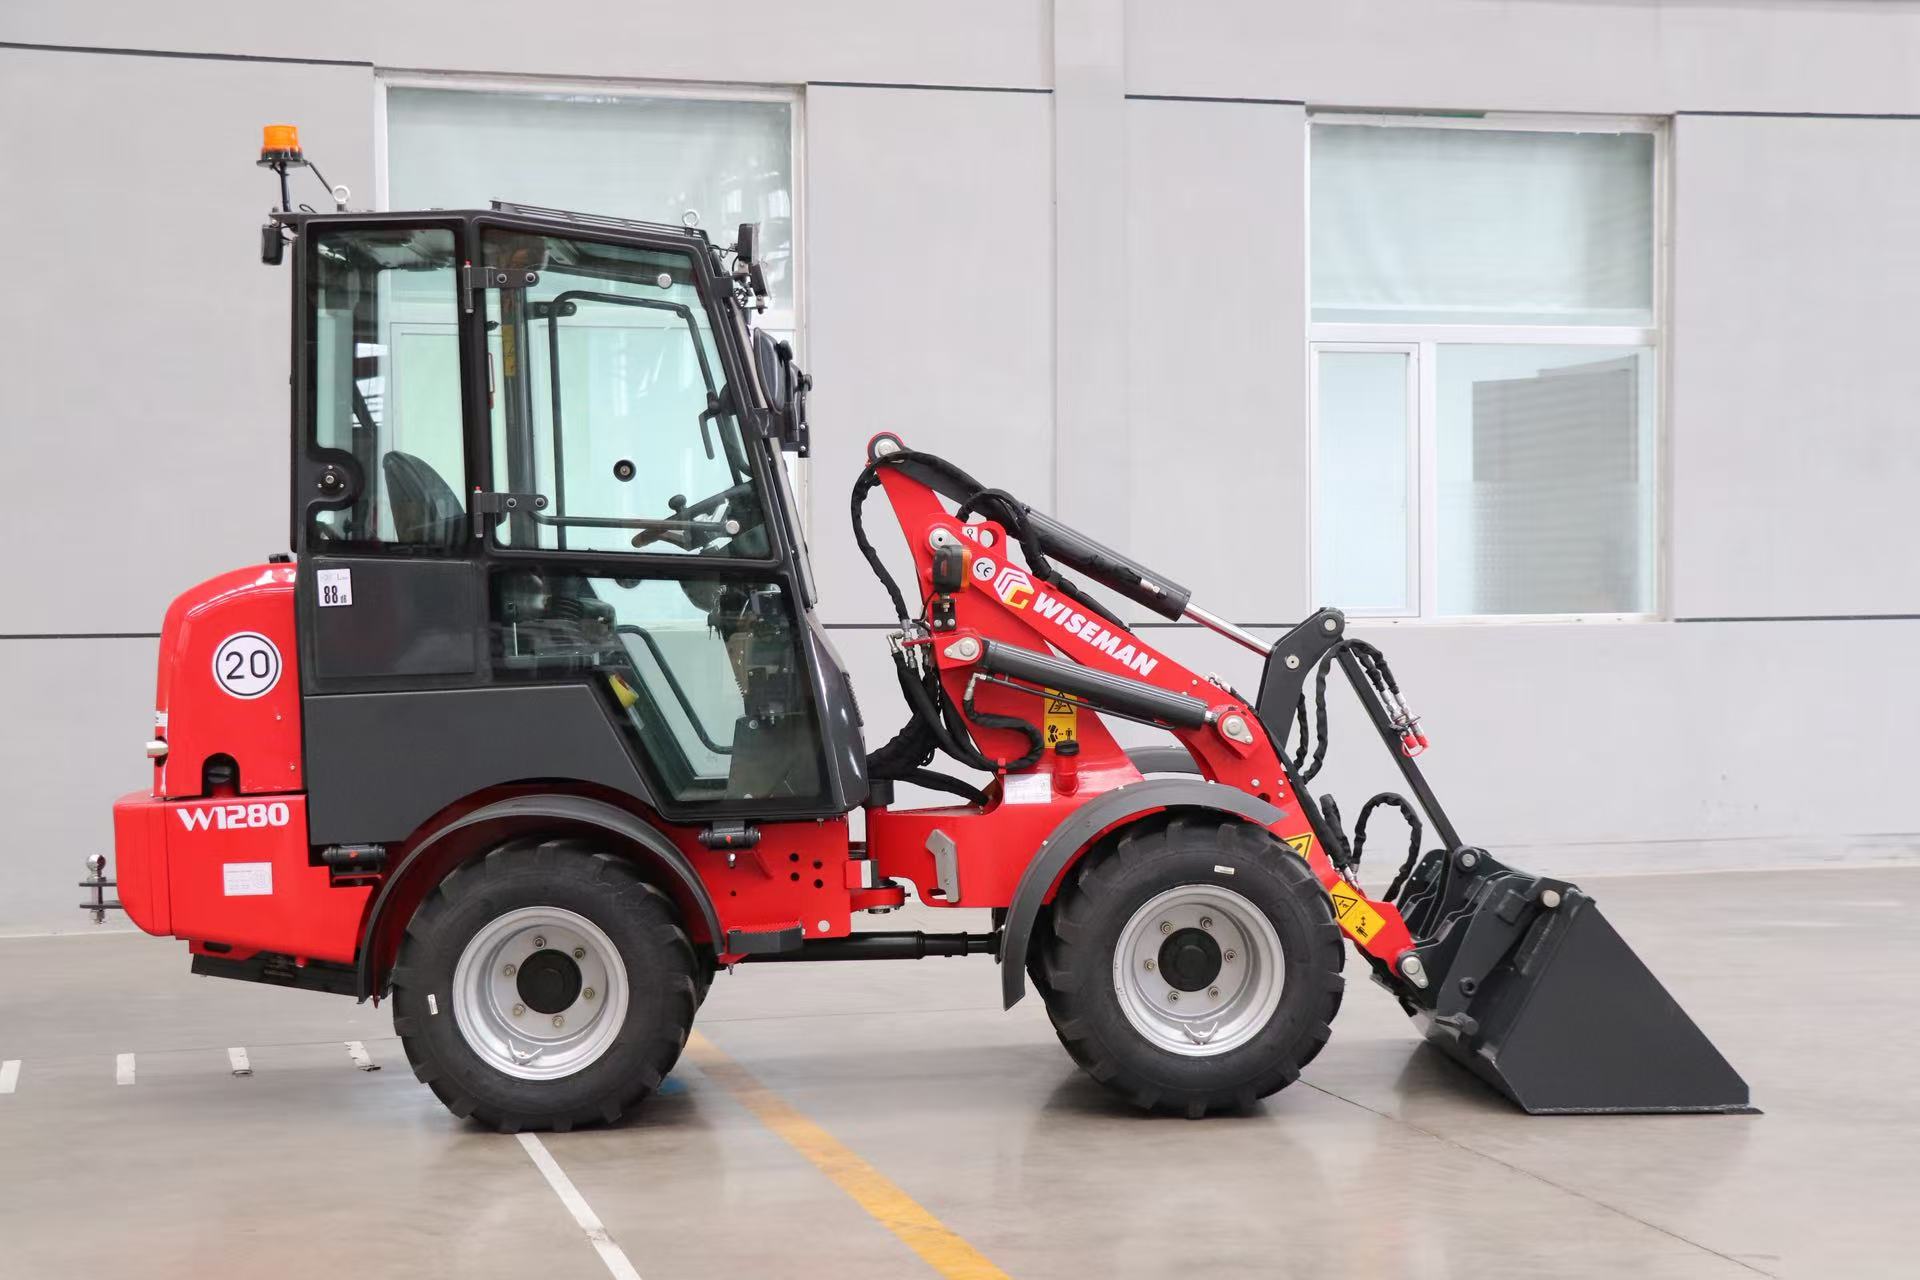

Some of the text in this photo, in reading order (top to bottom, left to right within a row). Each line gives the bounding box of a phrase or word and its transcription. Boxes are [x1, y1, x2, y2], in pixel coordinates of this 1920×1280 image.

[976, 562, 993, 578] CE
[323, 585, 338, 604] 88
[1032, 592, 1158, 677] WISEMAN
[225, 650, 270, 680] 20
[176, 802, 290, 832] W1280
